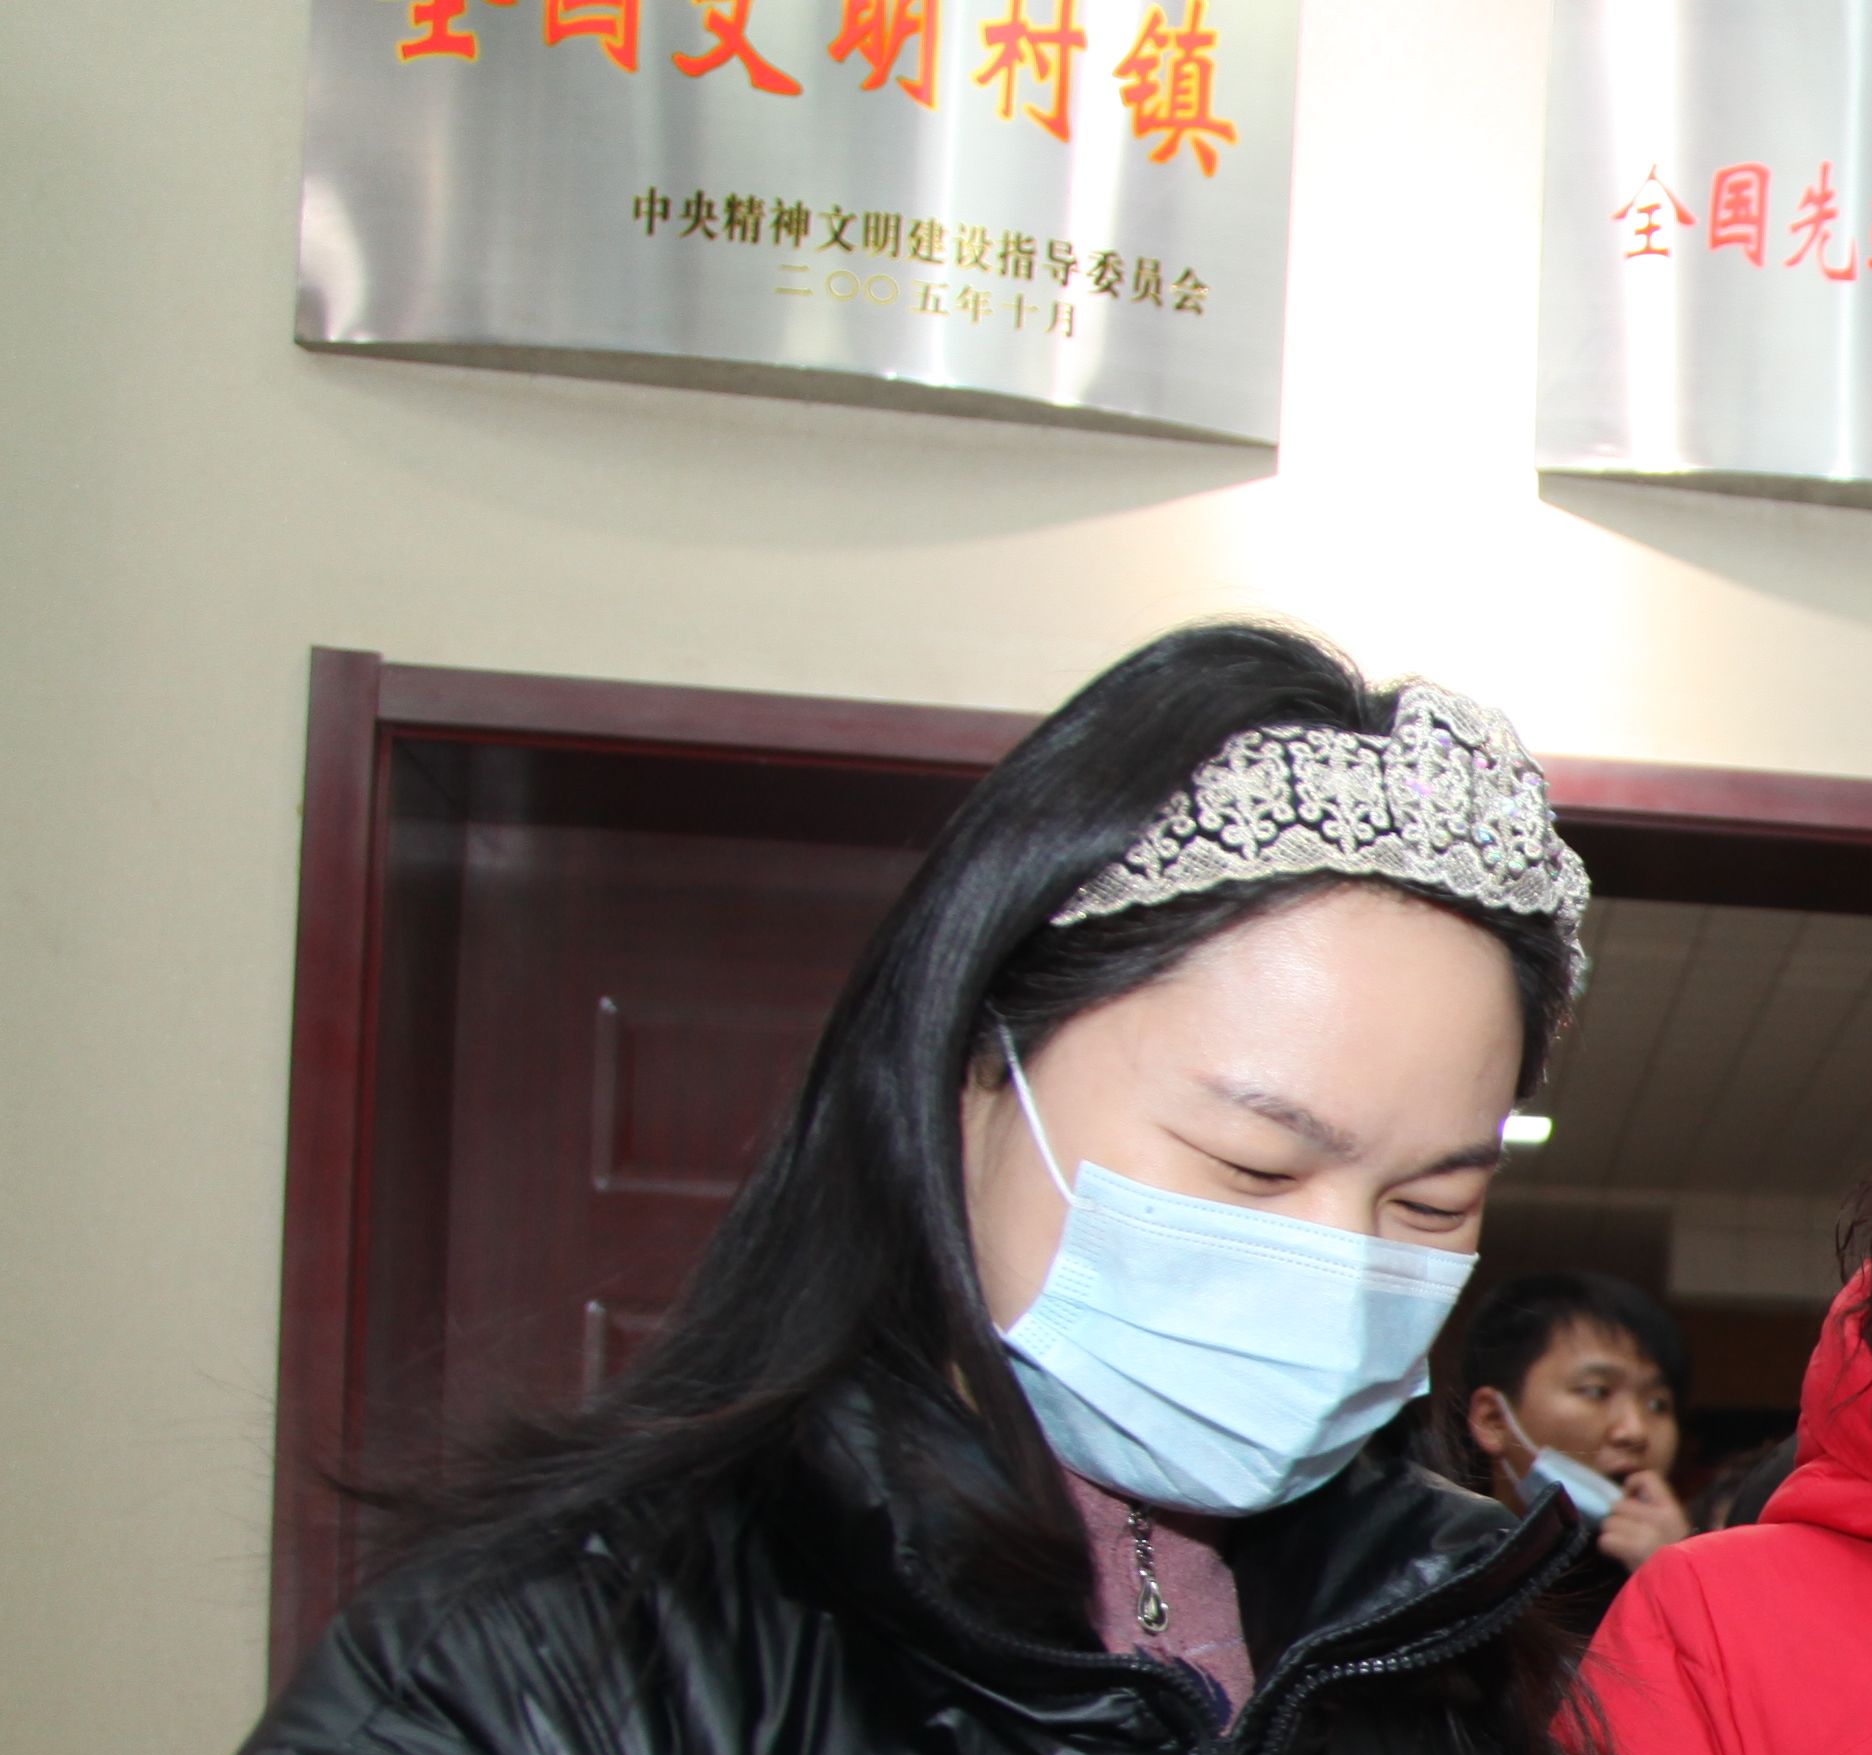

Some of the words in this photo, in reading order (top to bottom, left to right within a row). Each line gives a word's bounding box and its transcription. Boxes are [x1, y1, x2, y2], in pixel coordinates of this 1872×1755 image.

[632, 186, 1211, 316] 中央精神文明建设指导委员会
